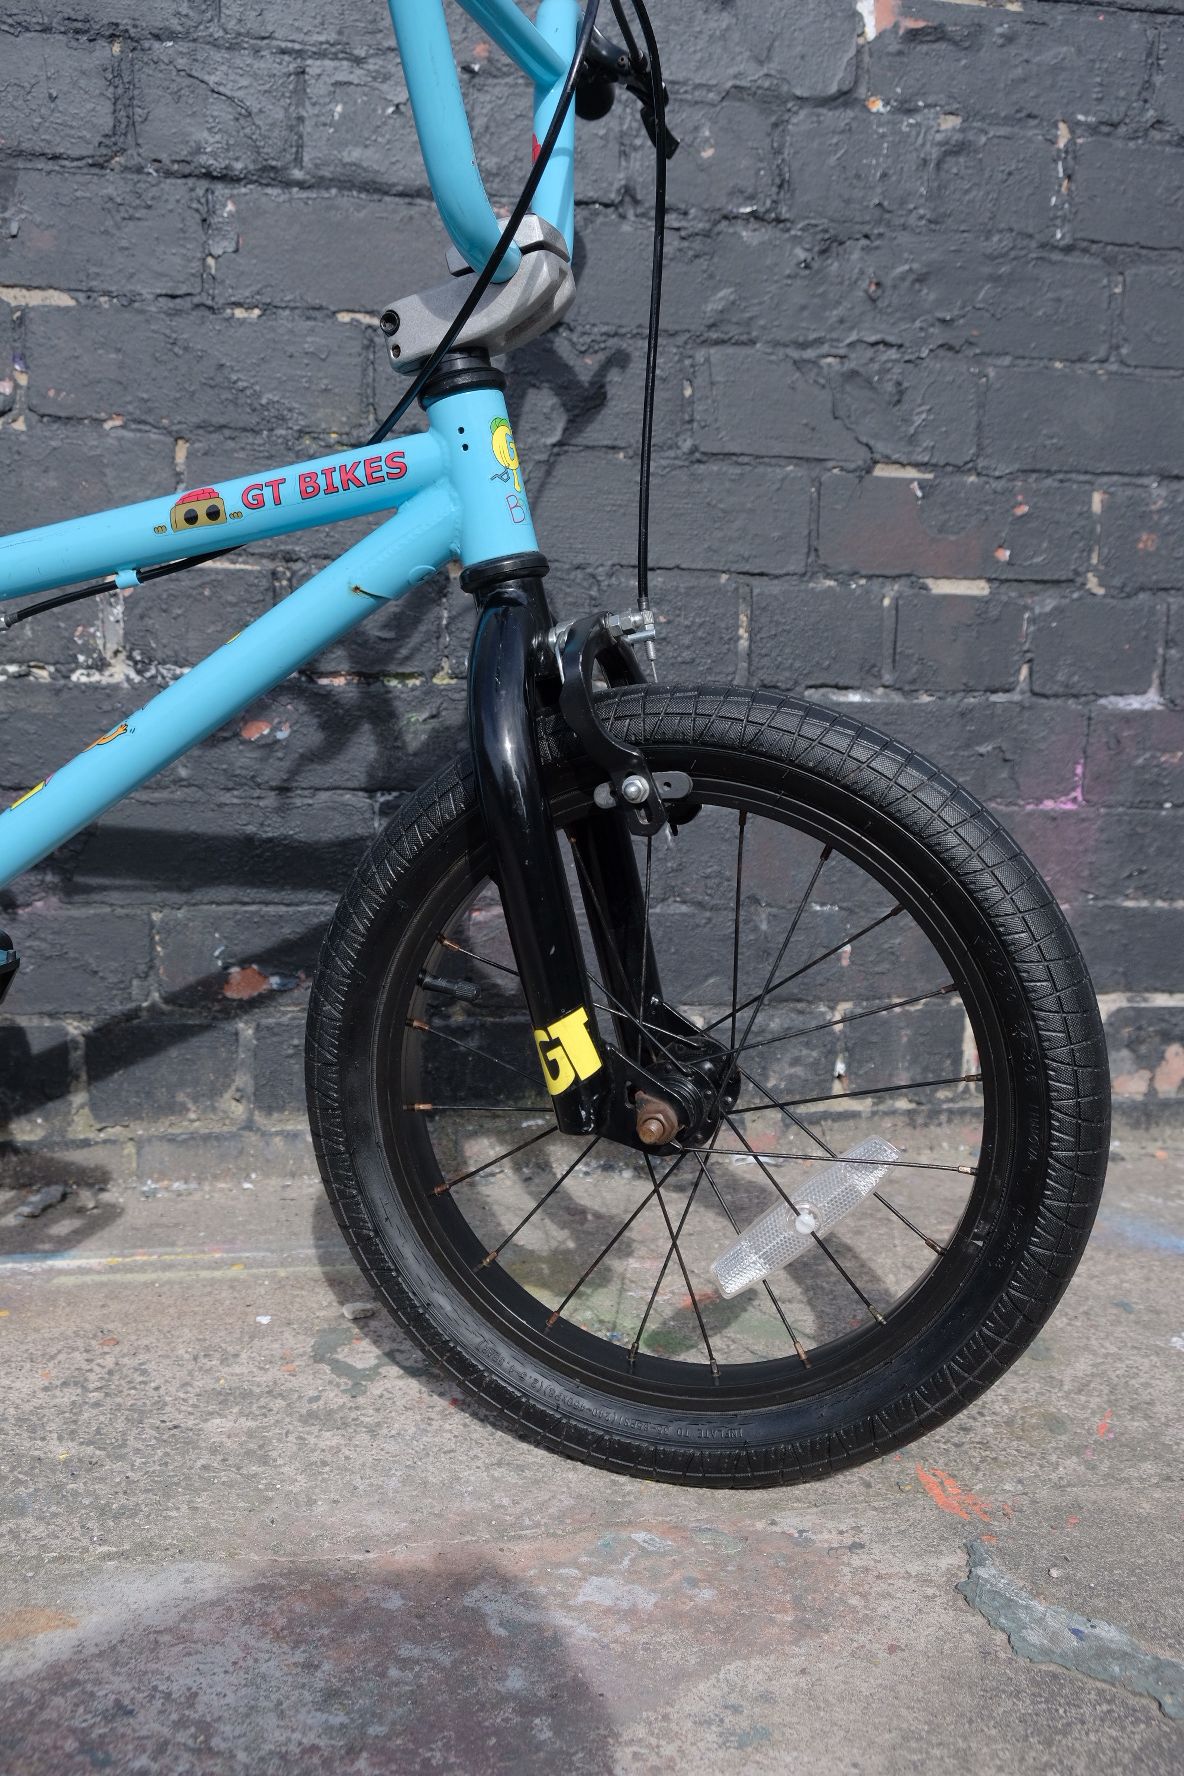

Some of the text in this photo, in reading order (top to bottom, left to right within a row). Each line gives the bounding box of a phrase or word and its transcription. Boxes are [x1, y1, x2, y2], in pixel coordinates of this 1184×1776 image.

[241, 450, 408, 511] GT BIKES
[533, 1005, 603, 1096] GT
